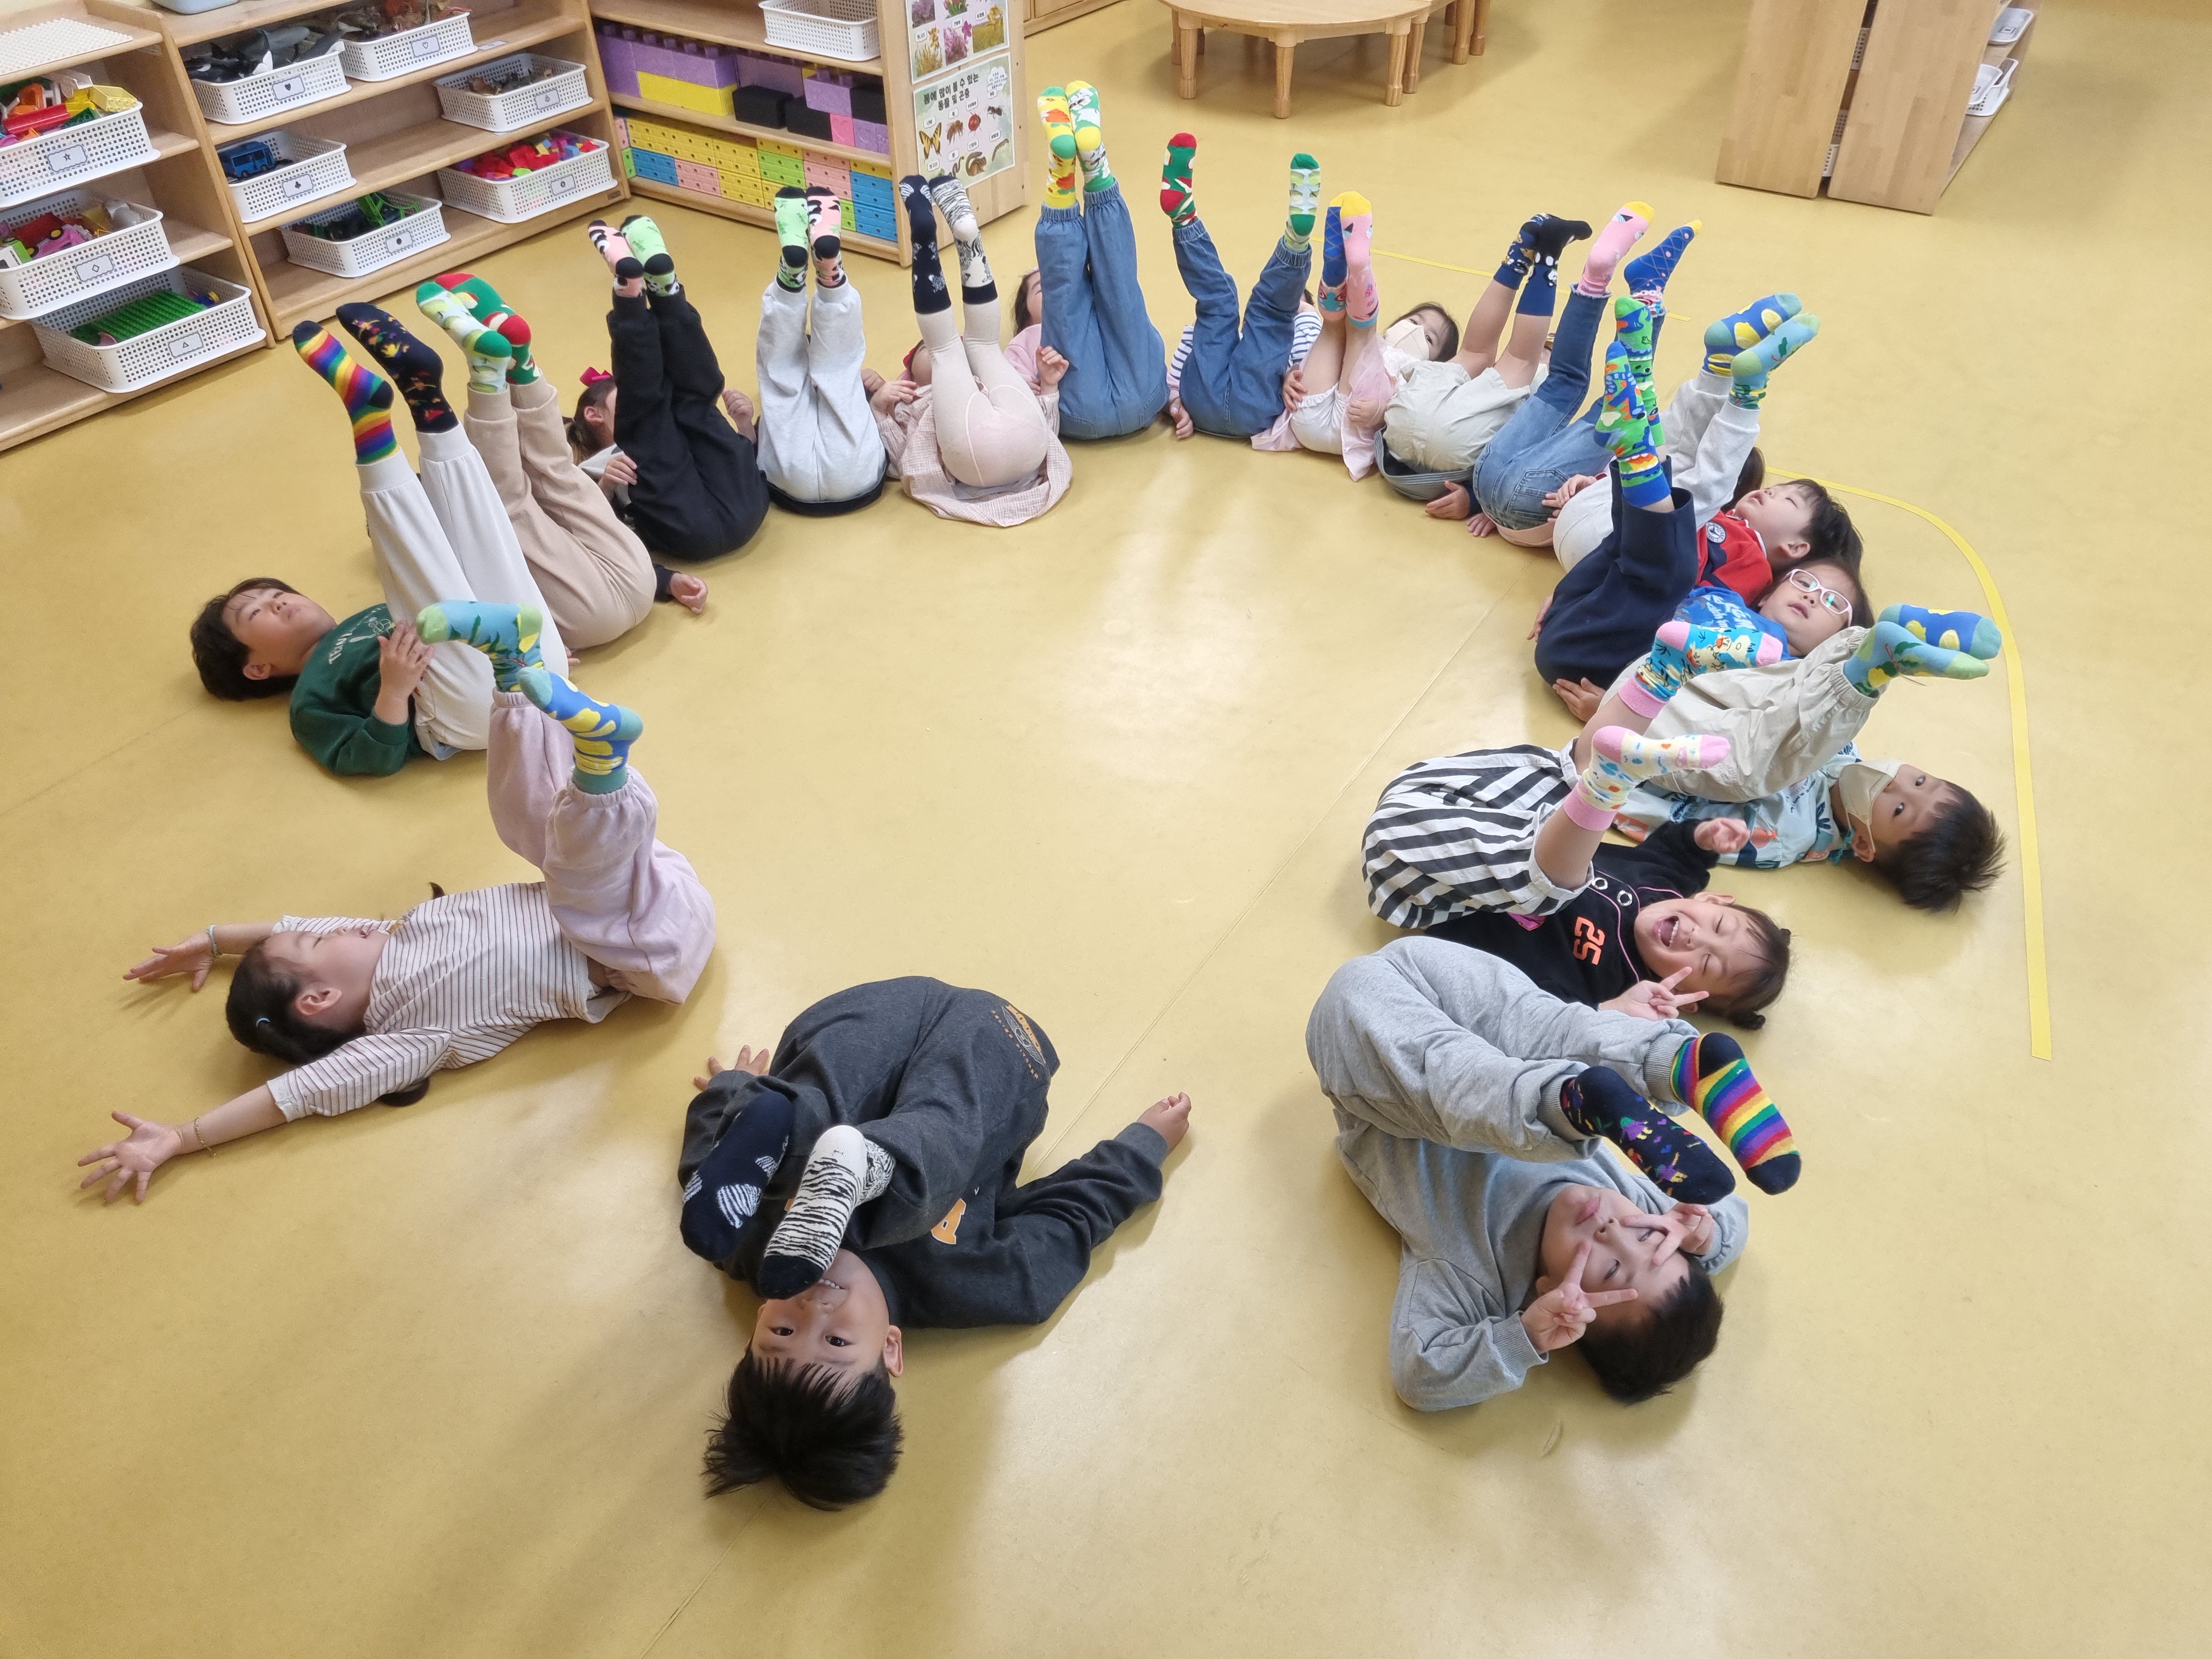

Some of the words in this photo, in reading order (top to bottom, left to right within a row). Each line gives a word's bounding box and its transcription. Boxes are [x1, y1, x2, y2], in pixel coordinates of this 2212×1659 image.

[924, 91, 937, 105] 봄에
[939, 84, 951, 98] 많이
[953, 81, 958, 93] 볼
[960, 78, 965, 88] 수
[967, 73, 979, 86] 있는
[938, 98, 950, 111] 동물
[952, 94, 957, 105] 및
[959, 88, 969, 101] 곤충
[1573, 916, 1606, 966] 25
